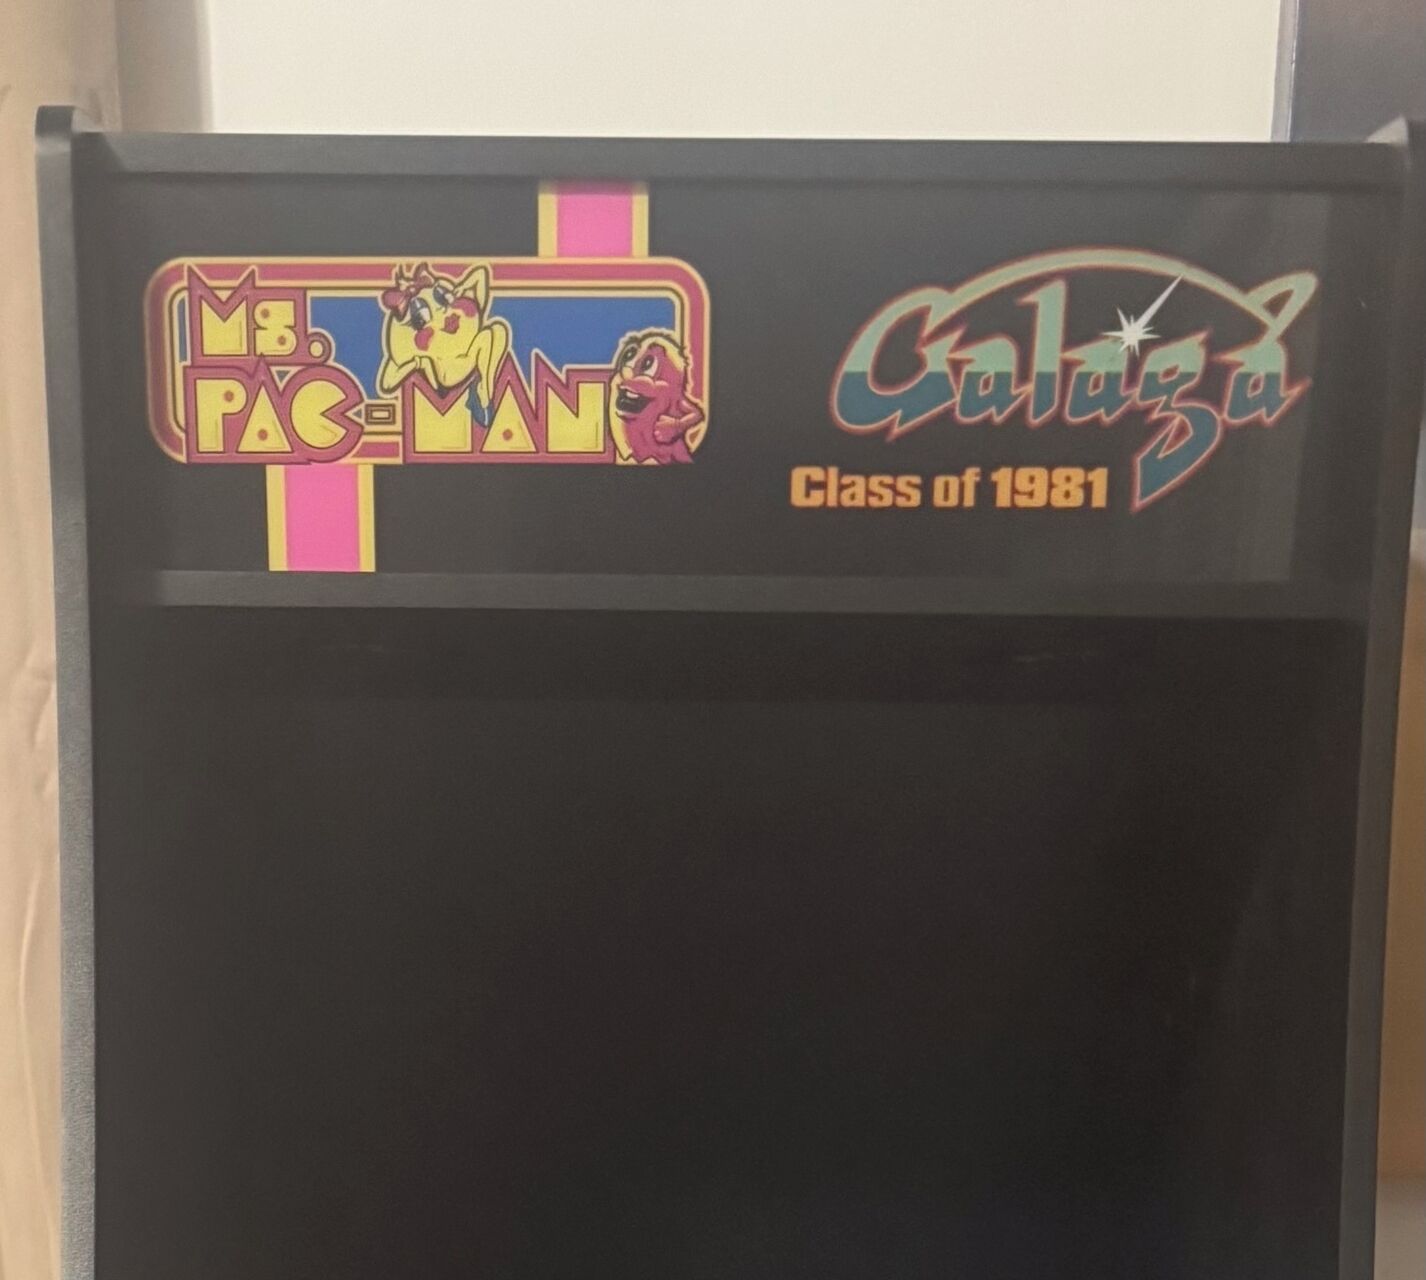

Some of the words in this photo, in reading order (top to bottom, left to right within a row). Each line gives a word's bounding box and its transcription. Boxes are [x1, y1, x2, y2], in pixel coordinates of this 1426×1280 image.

[184, 350, 616, 464] PAC-MAN
[830, 243, 1318, 512] Galaga
[790, 466, 921, 509] Class
[931, 466, 981, 509] of
[991, 466, 1109, 509] 1981
